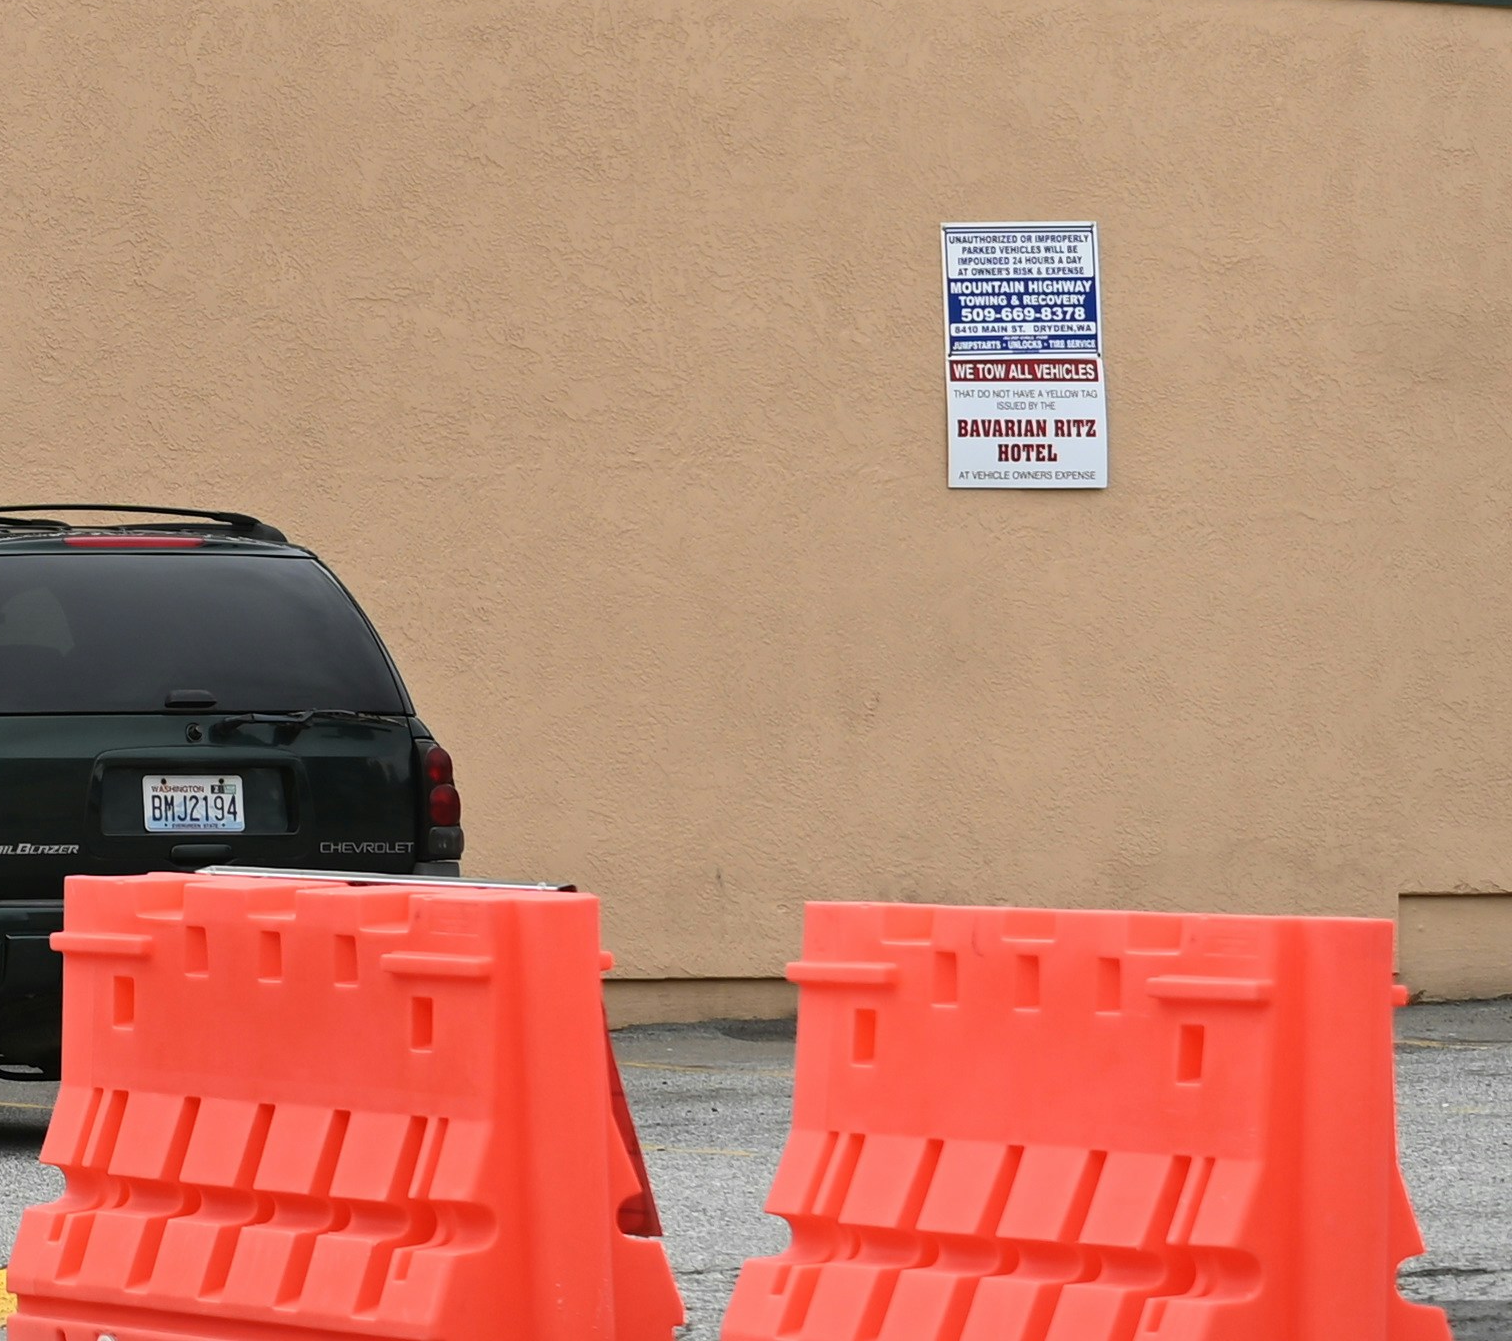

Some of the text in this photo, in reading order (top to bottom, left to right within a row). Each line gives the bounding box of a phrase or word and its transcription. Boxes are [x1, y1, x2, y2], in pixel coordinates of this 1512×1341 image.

[948, 234, 1089, 244] UNAUTHORIZED OR IMPROPERLY
[961, 245, 1078, 255] PARKED VEHICLES WILL BE
[958, 256, 1082, 265] IMPOUNDED 24 HOURS A DAY
[957, 268, 968, 276] AT
[971, 268, 1010, 276] OWNER'S
[1013, 267, 1033, 275] RISK
[1045, 267, 1084, 275] EXPENSE
[950, 280, 1092, 294] MOUNTAIN HIGHWAY
[958, 294, 1086, 306] TOWING & RECOVERY
[961, 307, 1086, 322] 509-669-8378
[955, 325, 978, 334] 8410
[981, 325, 1008, 333] MAIN
[1011, 325, 1026, 333] ST.
[952, 341, 1001, 350] JUMPSTARTS
[1067, 340, 1096, 348] SERVICE
[953, 364, 1095, 379] WE TOW ALL VEHICLES
[954, 390, 1098, 398] THAT DO NOT HAVE A YELLOW TAG
[997, 402, 1056, 410] ISSUED BY THE
[957, 419, 1097, 438] BAVARIAN RITZ
[997, 444, 1058, 462] HOTEL
[958, 471, 1096, 480] AT VEHICLE OWNERS EXPENSE
[151, 785, 205, 793] WASHINGTON
[151, 794, 238, 822] BMJ2194
[319, 842, 414, 853] CHEVROLET
